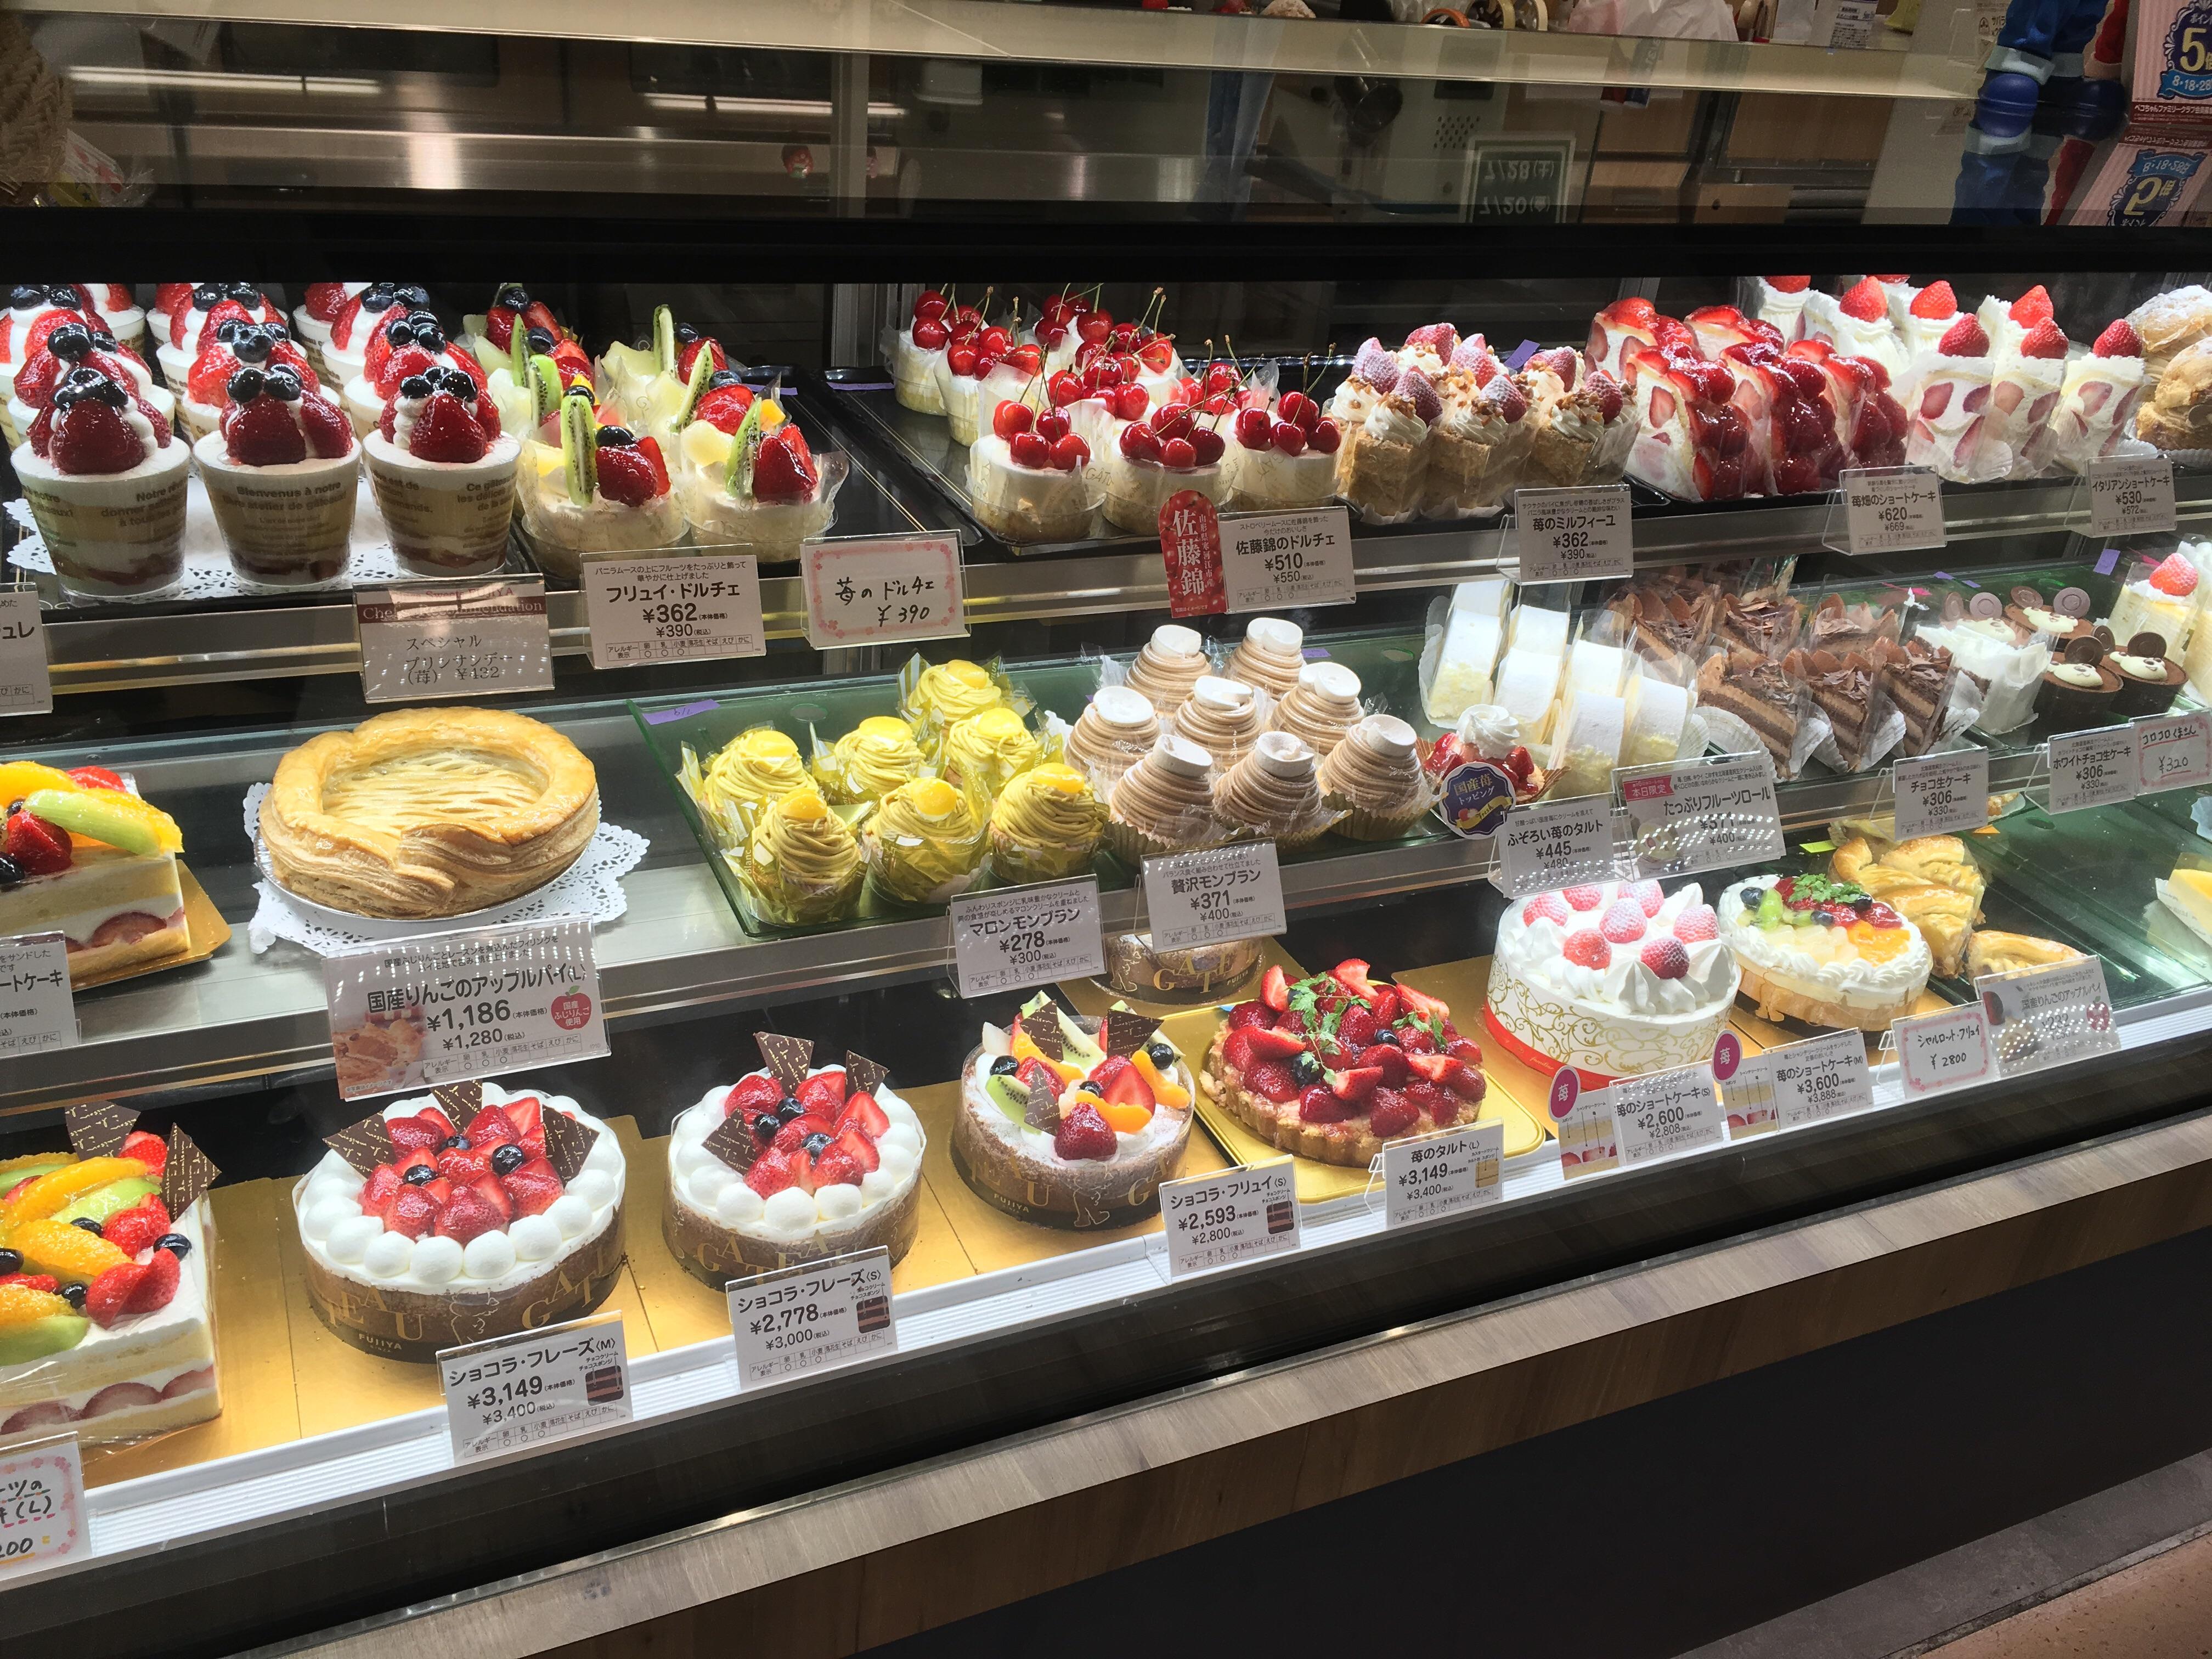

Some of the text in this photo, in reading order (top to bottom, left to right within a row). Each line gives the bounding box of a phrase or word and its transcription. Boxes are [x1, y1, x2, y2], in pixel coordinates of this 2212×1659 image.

[315, 481, 341, 494] notre
[2092, 476, 2170, 492] イタリアンショートケーキ
[2115, 490, 2142, 505] ¥530
[1878, 507, 1907, 521] ¥620
[2122, 506, 2139, 515] ¥572
[1533, 515, 1616, 531] 苺のミルフィーユ
[1884, 522, 1904, 532] ¥669
[1235, 533, 1335, 555] 佐藤錦のドルチェ
[1553, 532, 1588, 549] ¥362
[1173, 509, 1205, 596] 佐藤錦
[1265, 552, 1303, 571] ¥510
[1561, 549, 1584, 560] ¥390
[595, 561, 746, 575] バニラムースの上にフルーツをたっぷりと飾って
[637, 572, 709, 582] 華やかに仕上げました
[1273, 571, 1300, 583] ¥550
[606, 581, 740, 603] フリュイ・ドルチェ
[642, 602, 697, 623] ¥362
[656, 624, 692, 637] ¥390
[407, 635, 482, 651] スペシャル
[406, 652, 513, 670] プリンサンデー
[456, 667, 499, 680] ¥432
[2053, 746, 2131, 770] ホワイトチョコ生ケーキ
[2076, 765, 2103, 781] ¥306
[1454, 774, 1493, 794] 国産苺
[1632, 785, 1667, 797] 本日限定
[1911, 773, 1971, 793] チョコ生ケーキ
[2081, 779, 2099, 789] ¥330
[1458, 786, 1494, 805] トッピング
[1663, 786, 1770, 816] たっぷりフルーツロール
[1923, 790, 1952, 806] ¥306
[1928, 805, 1948, 816] ¥330
[1508, 820, 1603, 847] ふぞろい苺のタルト
[1709, 831, 1735, 844] ¥400
[1536, 840, 1571, 860] ¥445
[1171, 870, 1261, 894] 贅沢モンブラン
[1190, 890, 1230, 910] ¥371
[970, 909, 1080, 936] マロンモンブラン
[1200, 908, 1229, 922] ¥400
[1000, 931, 1045, 952] ¥278
[1010, 950, 1041, 965] ¥300
[2022, 983, 2102, 1009] 国産りんごのアップルパイ
[427, 1000, 511, 1032] ¥1,186
[554, 1006, 590, 1020] ふじりんご
[566, 1018, 580, 1026] 使用
[442, 1029, 503, 1050] ¥1,280
[424, 1058, 458, 1069] アレルギー
[1720, 1047, 1730, 1065] 苺
[1558, 1084, 1568, 1101] 苺
[1797, 1073, 1839, 1094] ¥3,600
[1808, 1090, 1836, 1103] ¥3,888
[1638, 1107, 1684, 1130] ¥2,600
[1649, 1124, 1680, 1139] ¥2,808
[1399, 1163, 1448, 1186] ¥3,149
[1407, 1184, 1441, 1200] ¥3,400
[993, 1193, 1030, 1214] FUJIYA
[1178, 1205, 1235, 1231] ¥2,593
[1192, 1227, 1230, 1245] ¥2,800
[751, 1304, 819, 1335] ¥2,778
[358, 1333, 403, 1351] FUJIYA
[766, 1329, 812, 1351] ¥3,000
[467, 1376, 543, 1409] ¥3,149
[483, 1402, 535, 1425] ¥3,400
